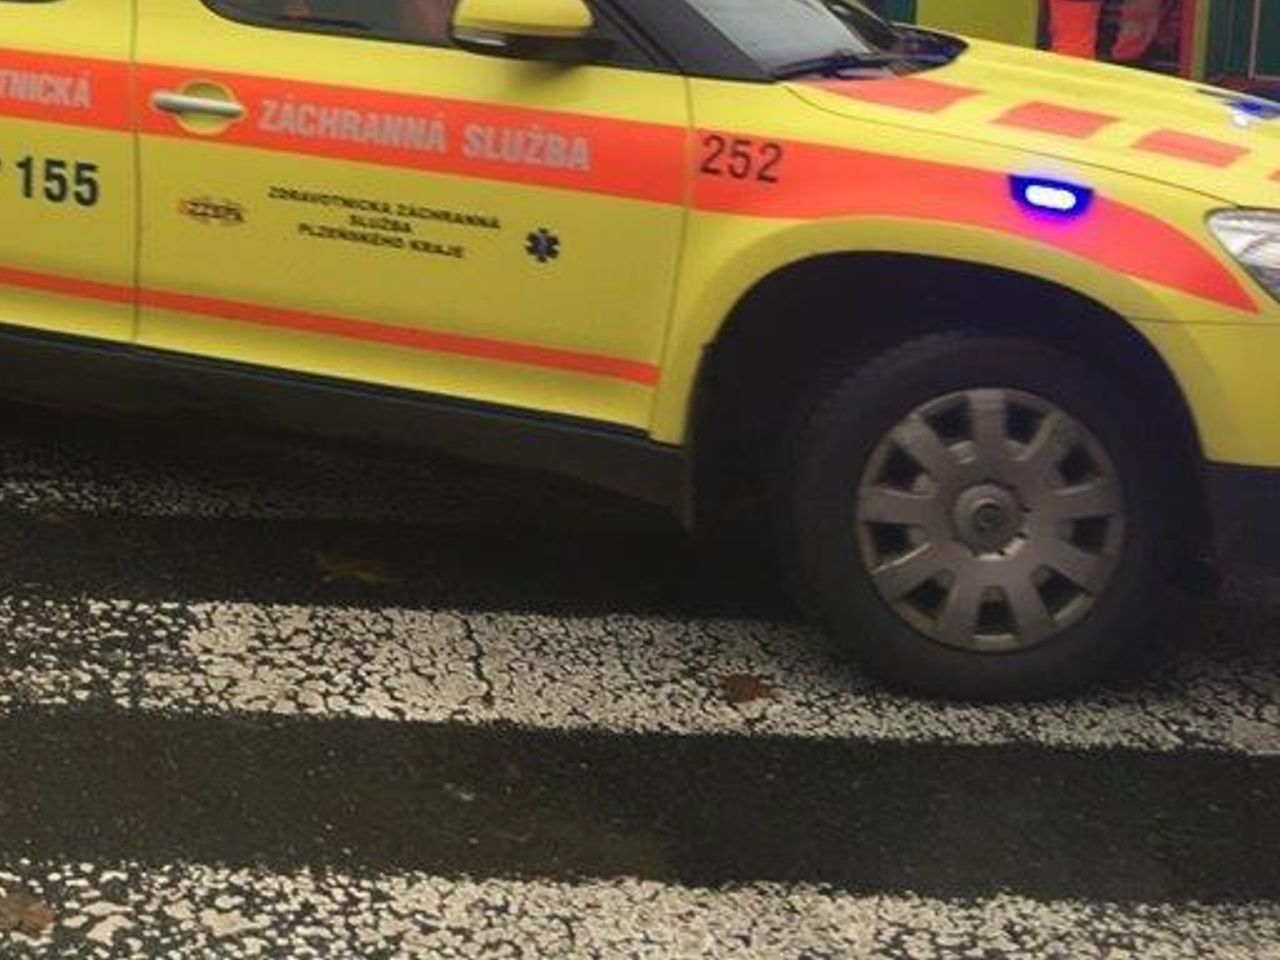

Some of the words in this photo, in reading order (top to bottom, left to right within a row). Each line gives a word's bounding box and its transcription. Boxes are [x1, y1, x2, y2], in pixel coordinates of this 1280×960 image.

[257, 93, 448, 153] ZÁCHRANNÁ
[461, 122, 592, 172] SLUŽBA
[700, 134, 784, 183] 252
[16, 155, 100, 207] 155
